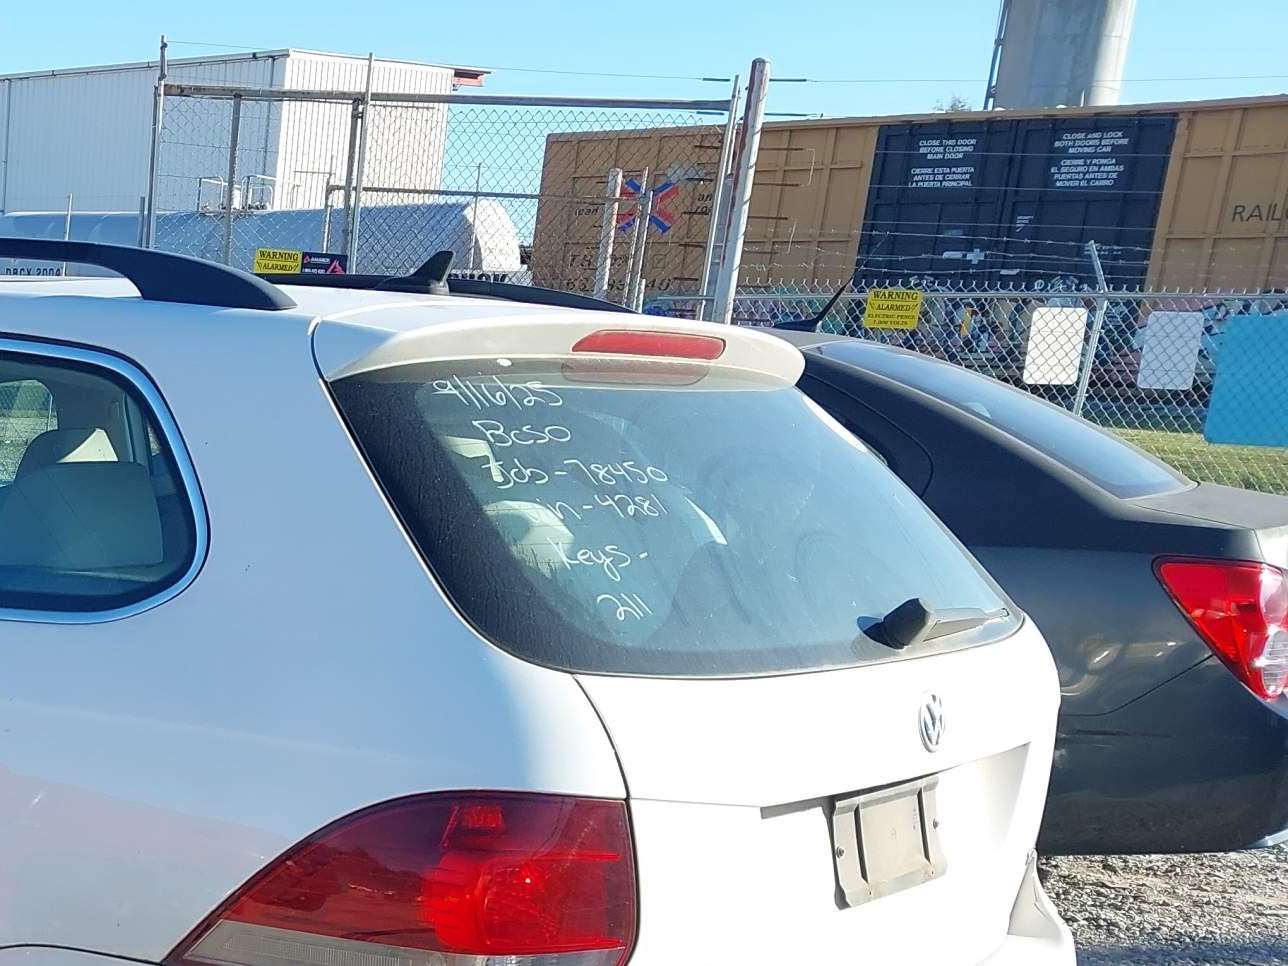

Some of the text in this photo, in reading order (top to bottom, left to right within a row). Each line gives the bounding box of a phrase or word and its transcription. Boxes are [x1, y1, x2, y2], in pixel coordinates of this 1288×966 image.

[1232, 203, 1288, 222] RAIL
[259, 250, 299, 261] WARNING
[262, 262, 293, 272] ALARMED
[873, 290, 919, 300] WARNING
[875, 303, 911, 311] ALARMED
[431, 375, 563, 411] 9/16/25
[597, 592, 653, 620] 211
